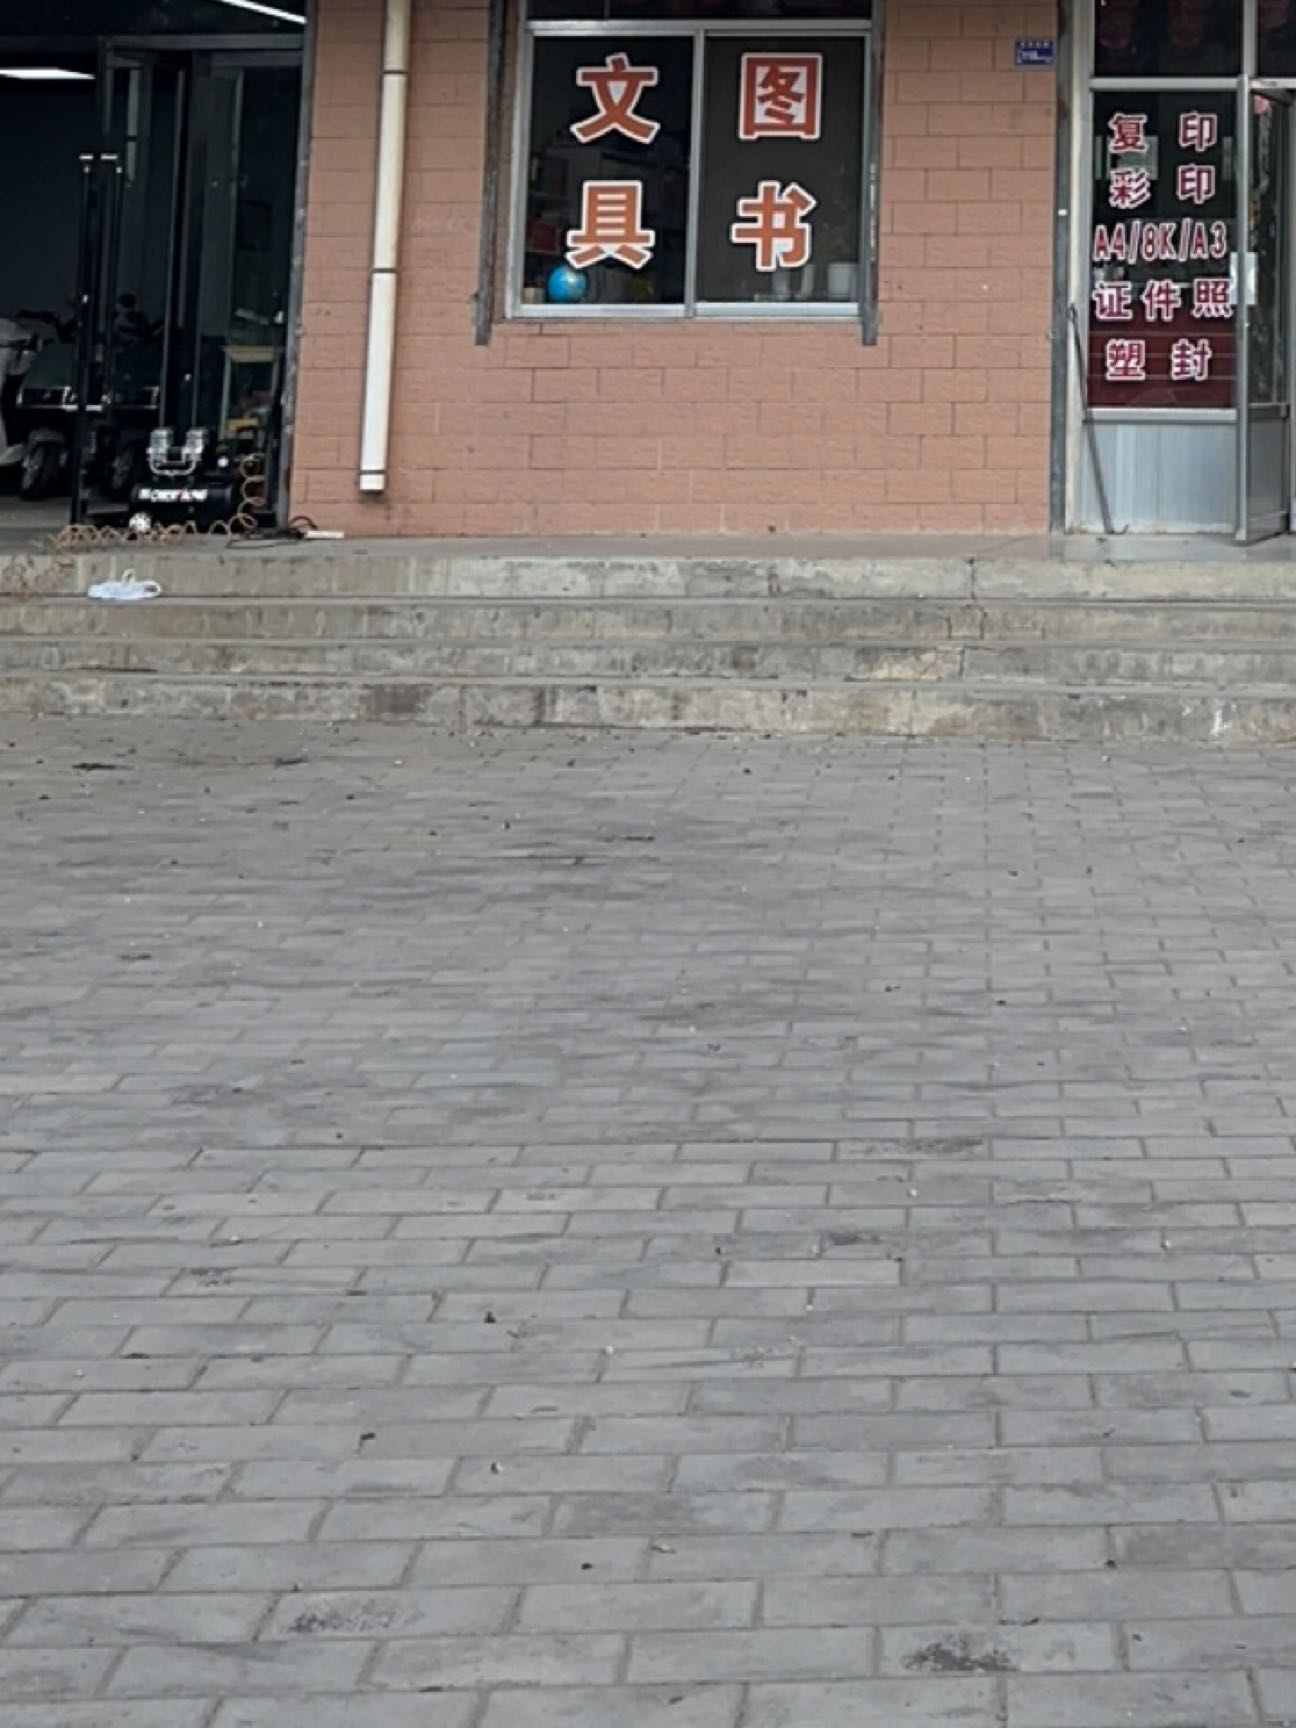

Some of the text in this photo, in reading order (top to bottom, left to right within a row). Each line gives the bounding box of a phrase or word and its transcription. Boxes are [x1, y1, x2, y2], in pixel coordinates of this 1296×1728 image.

[1109, 111, 1218, 153] 复印
[564, 52, 661, 270] 文具
[730, 52, 824, 272] 图书
[1109, 164, 1216, 209] 彩印
[1093, 218, 1227, 264] A4/8K/A3
[1092, 278, 1234, 321] 证件照
[1106, 338, 1212, 381] 塑封
